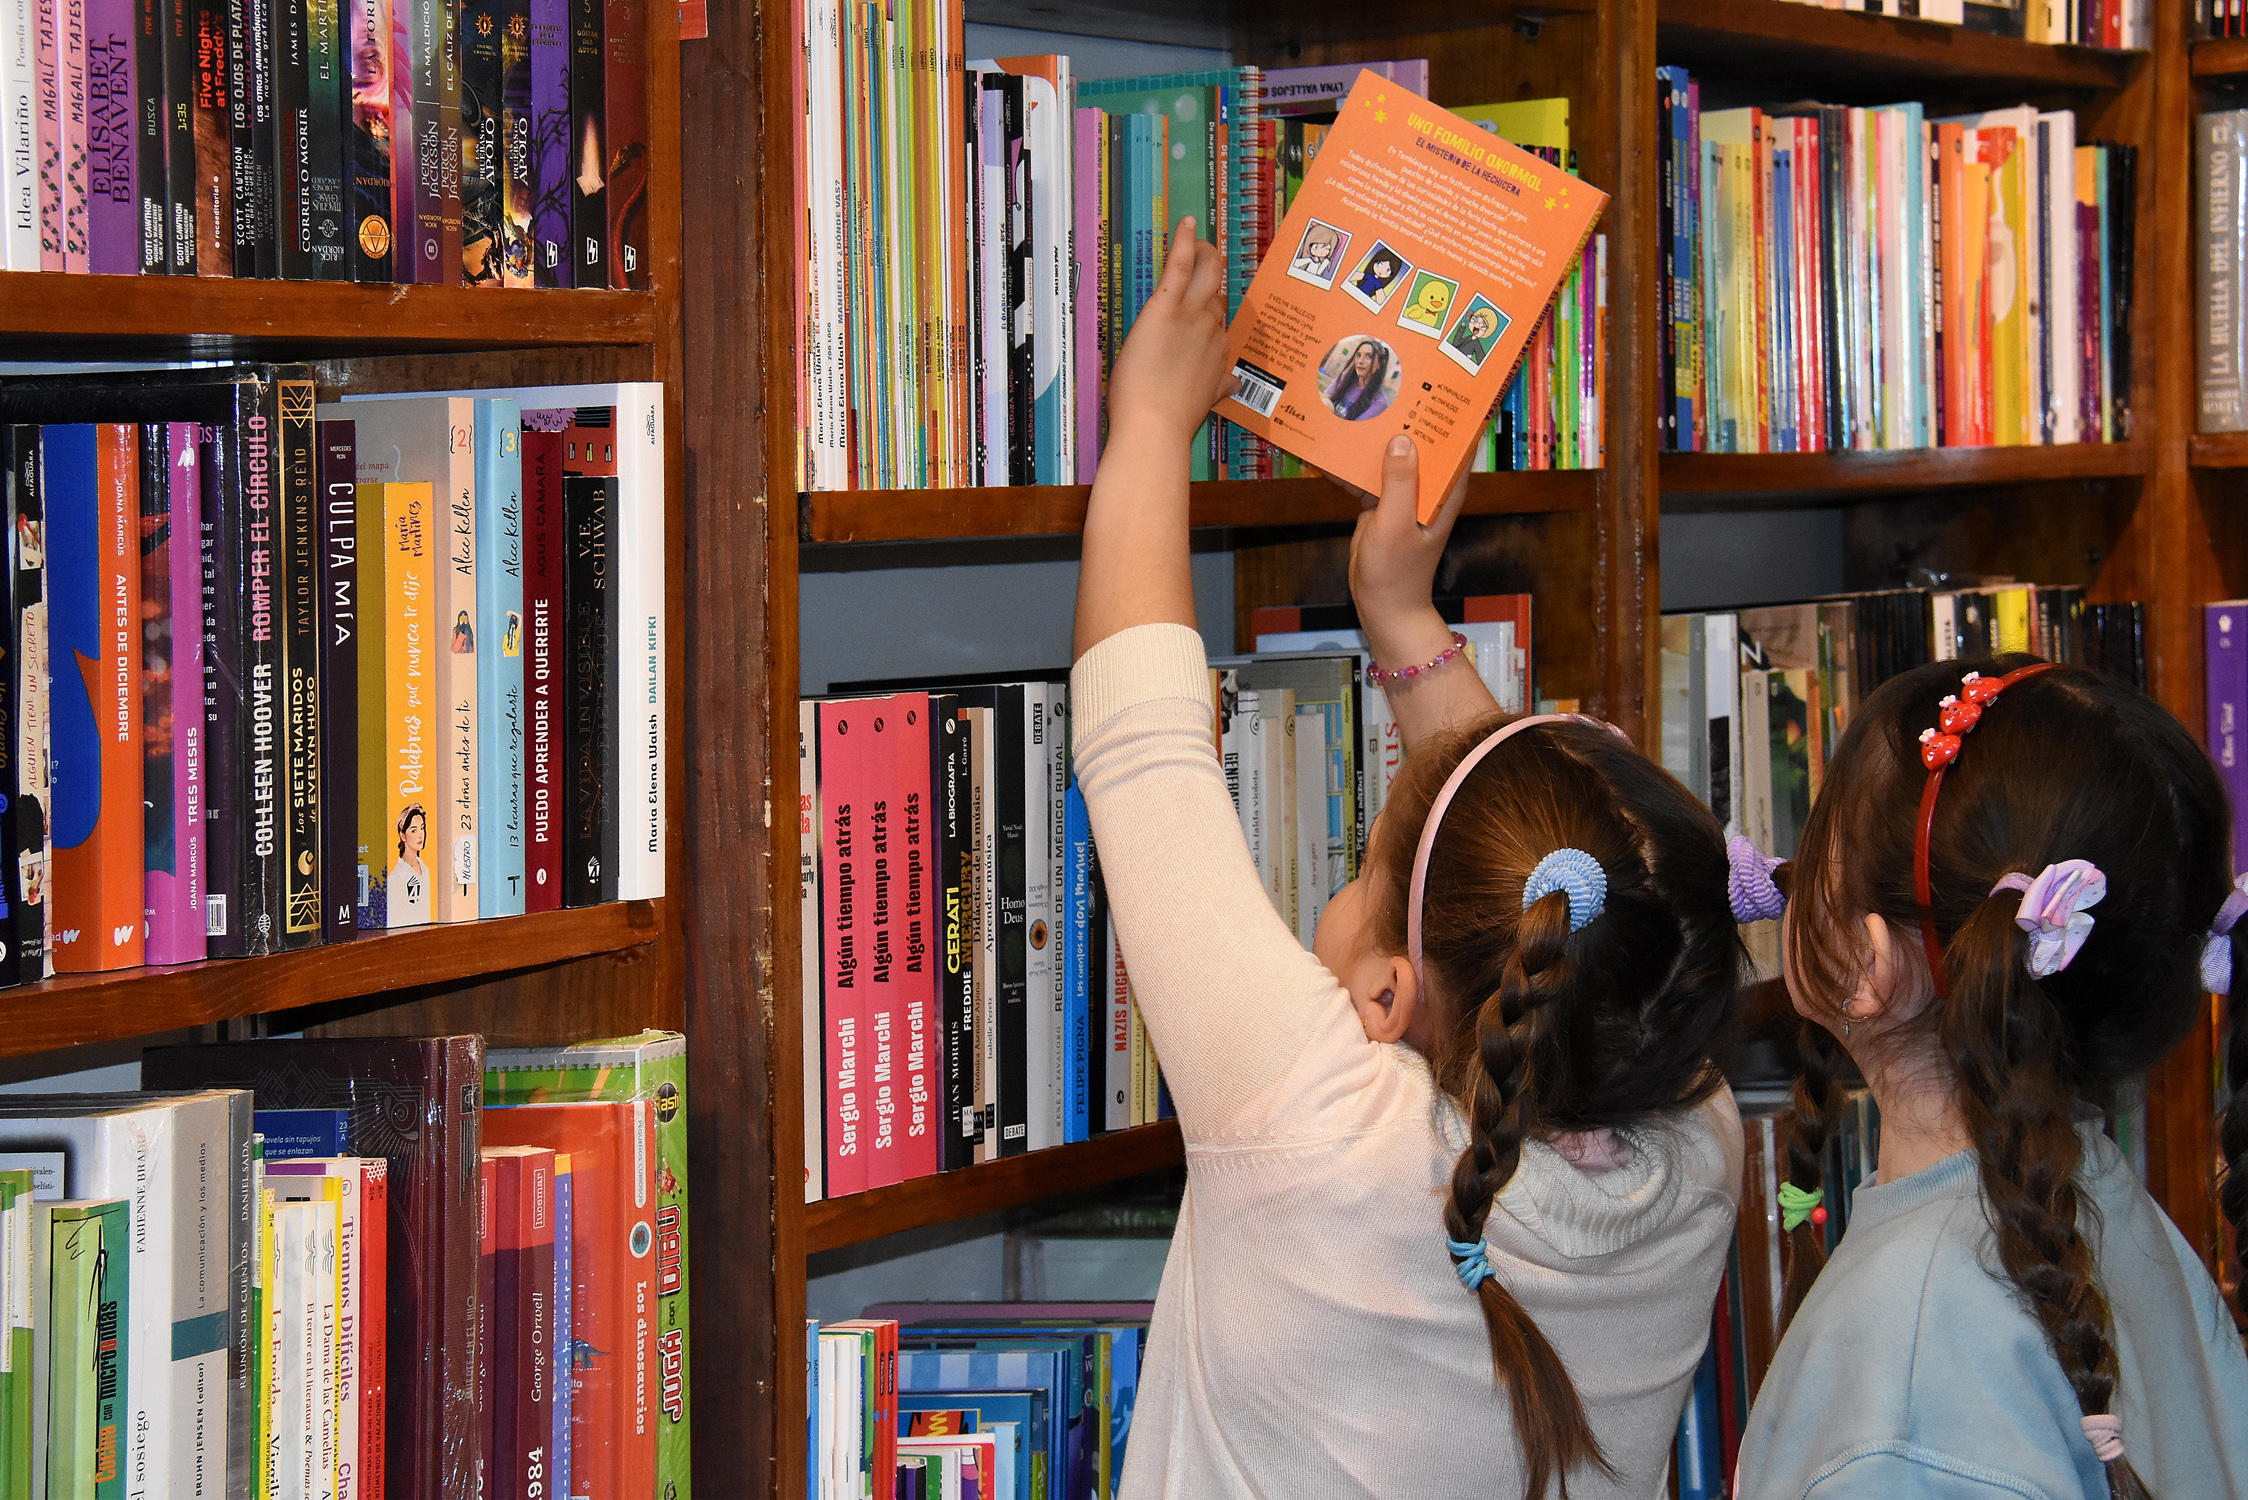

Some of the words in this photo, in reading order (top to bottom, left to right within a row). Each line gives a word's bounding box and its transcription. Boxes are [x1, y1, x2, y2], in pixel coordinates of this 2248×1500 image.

[198, 10, 213, 68] Nights
[233, 42, 243, 59] DE
[67, 61, 84, 124] MAGALÍ
[200, 72, 213, 108] Five
[216, 90, 226, 108] at
[233, 63, 245, 98] OJOS
[1271, 84, 1319, 97] VALLEJOS
[1320, 81, 1344, 94] LYNA
[15, 94, 30, 176] Vilariño
[88, 39, 111, 195] ELÍSABET
[109, 33, 130, 205] BENAVENT
[147, 97, 156, 136] BUSCA
[234, 101, 245, 128] LOS
[299, 108, 309, 165] MORIR
[1209, 121, 1216, 132] De
[518, 118, 528, 186] APOLO
[1207, 133, 1216, 159] mayor
[1415, 136, 1425, 147] EL
[1425, 140, 1460, 165] MISTERIO
[1461, 158, 1470, 171] DE
[1471, 164, 1481, 175] LA
[1482, 167, 1521, 197] HECHICERA
[301, 167, 309, 182] O
[1207, 160, 1216, 186] quiero
[2210, 151, 2229, 232] INFIERNO
[17, 186, 32, 230] Idea
[144, 197, 152, 237] CAWTHON
[301, 186, 311, 253] CORRER
[1208, 208, 1217, 226] feliz
[145, 240, 153, 266] SCOTT
[2210, 240, 2229, 271] DEL
[2210, 280, 2229, 345] HUELLA
[2211, 353, 2229, 374] LA
[838, 411, 846, 448] María
[246, 416, 270, 509] CÍRCULO
[293, 447, 307, 487] REID
[251, 517, 269, 543] EL
[295, 495, 309, 567] JENKINS
[329, 482, 355, 567] CULPA
[396, 515, 411, 552] María
[407, 499, 424, 557] Martínez
[453, 488, 473, 538] Kellen
[579, 517, 591, 559] V.E.
[592, 489, 606, 589] SCHWAB
[454, 539, 474, 575] Alice
[116, 574, 127, 628] ANTES
[251, 550, 272, 641] ROMPER
[297, 575, 310, 635] TAYLOR
[403, 571, 422, 600] dije
[404, 605, 419, 617] te
[333, 580, 351, 646] MÍA
[534, 598, 549, 680] QUERERTE
[647, 615, 657, 652] KIFKI
[25, 611, 38, 670] SECRETO
[117, 634, 128, 654] DE
[406, 623, 422, 677] nunca
[26, 675, 38, 692] UN
[118, 658, 130, 742] DICIEMBRE
[305, 676, 316, 731] HUGO
[407, 683, 421, 708] que
[535, 683, 548, 695] A
[648, 655, 657, 704] DAILAN
[26, 696, 38, 732] TIENE
[253, 663, 273, 751] HOOVER
[291, 667, 305, 757] MARIDOS
[27, 737, 39, 789] ALGUIEN
[186, 727, 198, 781] MESES
[398, 714, 425, 798] Palabras
[535, 699, 548, 784] APRENDER
[648, 714, 658, 760] Walsh
[292, 761, 305, 808] SIETE
[305, 734, 316, 805] EVELYN
[647, 763, 657, 804] Elena
[1054, 742, 1063, 792] RURAL
[1251, 770, 1259, 807] violeta
[188, 785, 198, 825] TRES
[254, 759, 273, 856] COLLEEN
[295, 812, 306, 834] Los
[535, 788, 548, 842] PUEDO
[647, 808, 657, 853] María
[833, 803, 852, 858] atrás
[903, 792, 921, 846] atrás
[948, 821, 956, 838] LA
[1052, 797, 1064, 858] MÉDICO
[188, 835, 197, 877] MARCÚS
[1055, 862, 1064, 889] UN
[1074, 841, 1086, 895] Manuel
[189, 879, 197, 912] JOANA
[837, 862, 856, 931] tiempo
[907, 850, 924, 916] tiempo
[961, 850, 972, 964] MERCURY
[1055, 894, 1064, 913] DE
[947, 887, 960, 974] CERATI
[1073, 898, 1086, 928] don
[836, 934, 857, 989] Algún
[907, 920, 926, 973] Algún
[1054, 918, 1064, 1012] RECUERDOS
[962, 970, 972, 1031] FREDDIE
[838, 1017, 858, 1087] Marchi
[907, 1002, 925, 1071] Marchi
[951, 1021, 959, 1079] MORRIS
[1076, 1015, 1085, 1058] PIGNA
[908, 1074, 930, 1137] Sergio
[952, 1084, 960, 1122] JUAN
[1076, 1061, 1085, 1115] FELIPE
[839, 1092, 860, 1157] Sergio
[197, 1142, 206, 1183] medios
[264, 1148, 276, 1156] que
[286, 1147, 314, 1155] enlazan
[136, 1185, 145, 1254] FABIENNE
[197, 1186, 206, 1203] los
[534, 1172, 544, 1225] lucemar
[196, 1214, 206, 1294] comunicación
[240, 1241, 249, 1303] CUENTOS
[657, 1205, 682, 1295] DIBU
[197, 1295, 206, 1309] La
[240, 1306, 248, 1324] DE
[322, 1303, 333, 1320] La
[531, 1292, 543, 1344] Orwell
[637, 1281, 647, 1314] Los
[668, 1301, 676, 1324] con
[97, 1301, 119, 1399] microondas
[238, 1328, 248, 1389] REUNIÓN
[322, 1323, 333, 1365] Dama
[340, 1315, 354, 1402] Difíciles
[195, 1361, 205, 1404] (editor)
[322, 1368, 333, 1384] de
[322, 1388, 332, 1405] las
[531, 1347, 544, 1402] George
[636, 1318, 647, 1435] dinosaurios
[102, 1403, 113, 1421] con
[196, 1407, 204, 1452] JENSEN
[94, 1424, 118, 1483] Cocina
[133, 1410, 148, 1483] sosiego
[321, 1407, 332, 1470] Camelias
[195, 1455, 203, 1496] BRUHN
